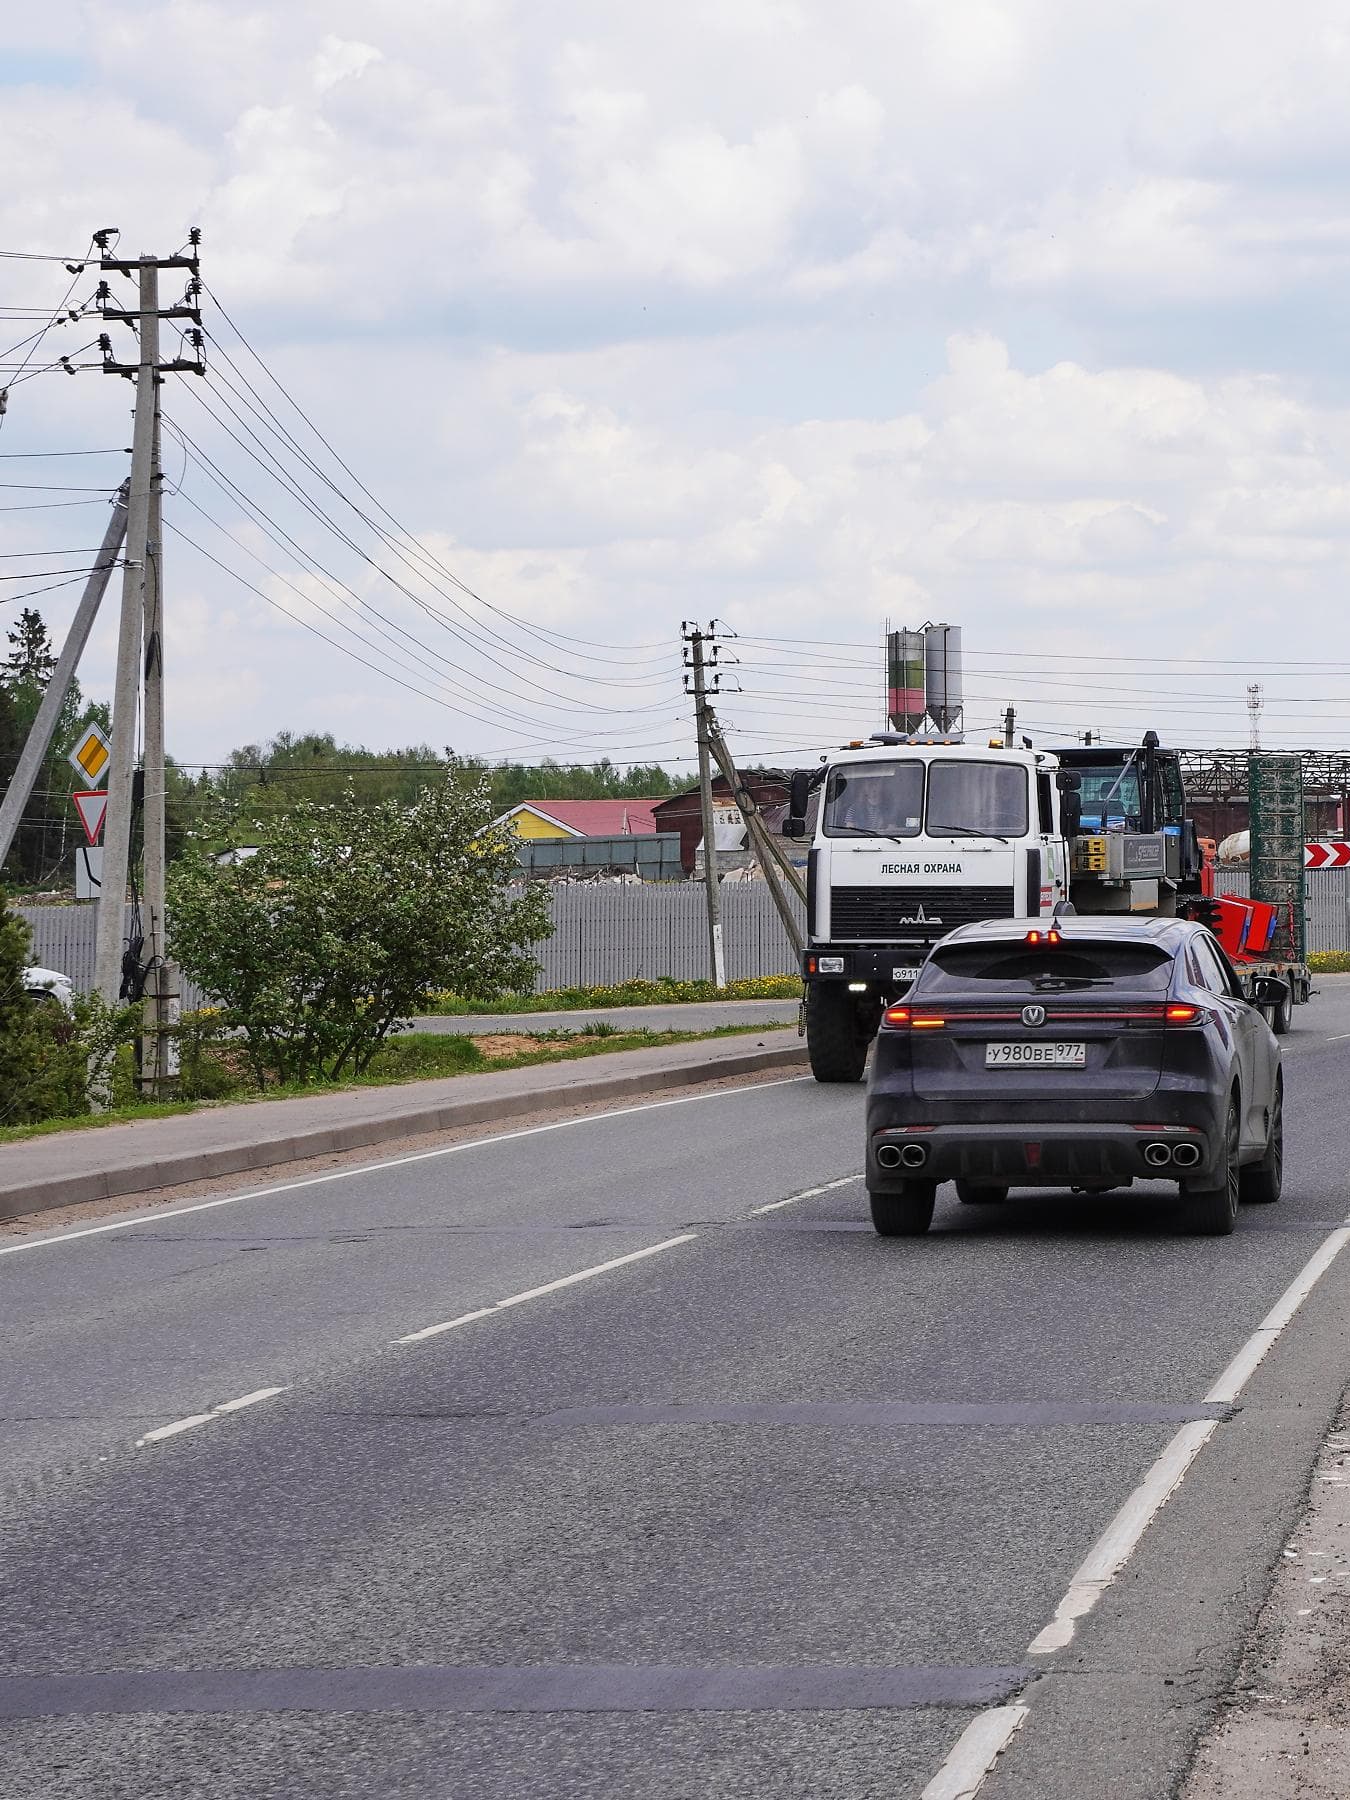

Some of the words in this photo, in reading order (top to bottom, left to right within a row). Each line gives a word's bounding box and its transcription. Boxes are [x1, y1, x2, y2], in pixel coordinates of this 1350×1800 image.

[881, 863, 920, 874] ЛЕСНАЯ
[923, 863, 962, 874] ОХРАНА
[992, 1045, 1054, 1061] У980ВЕ
[1057, 1044, 1081, 1057] 977
